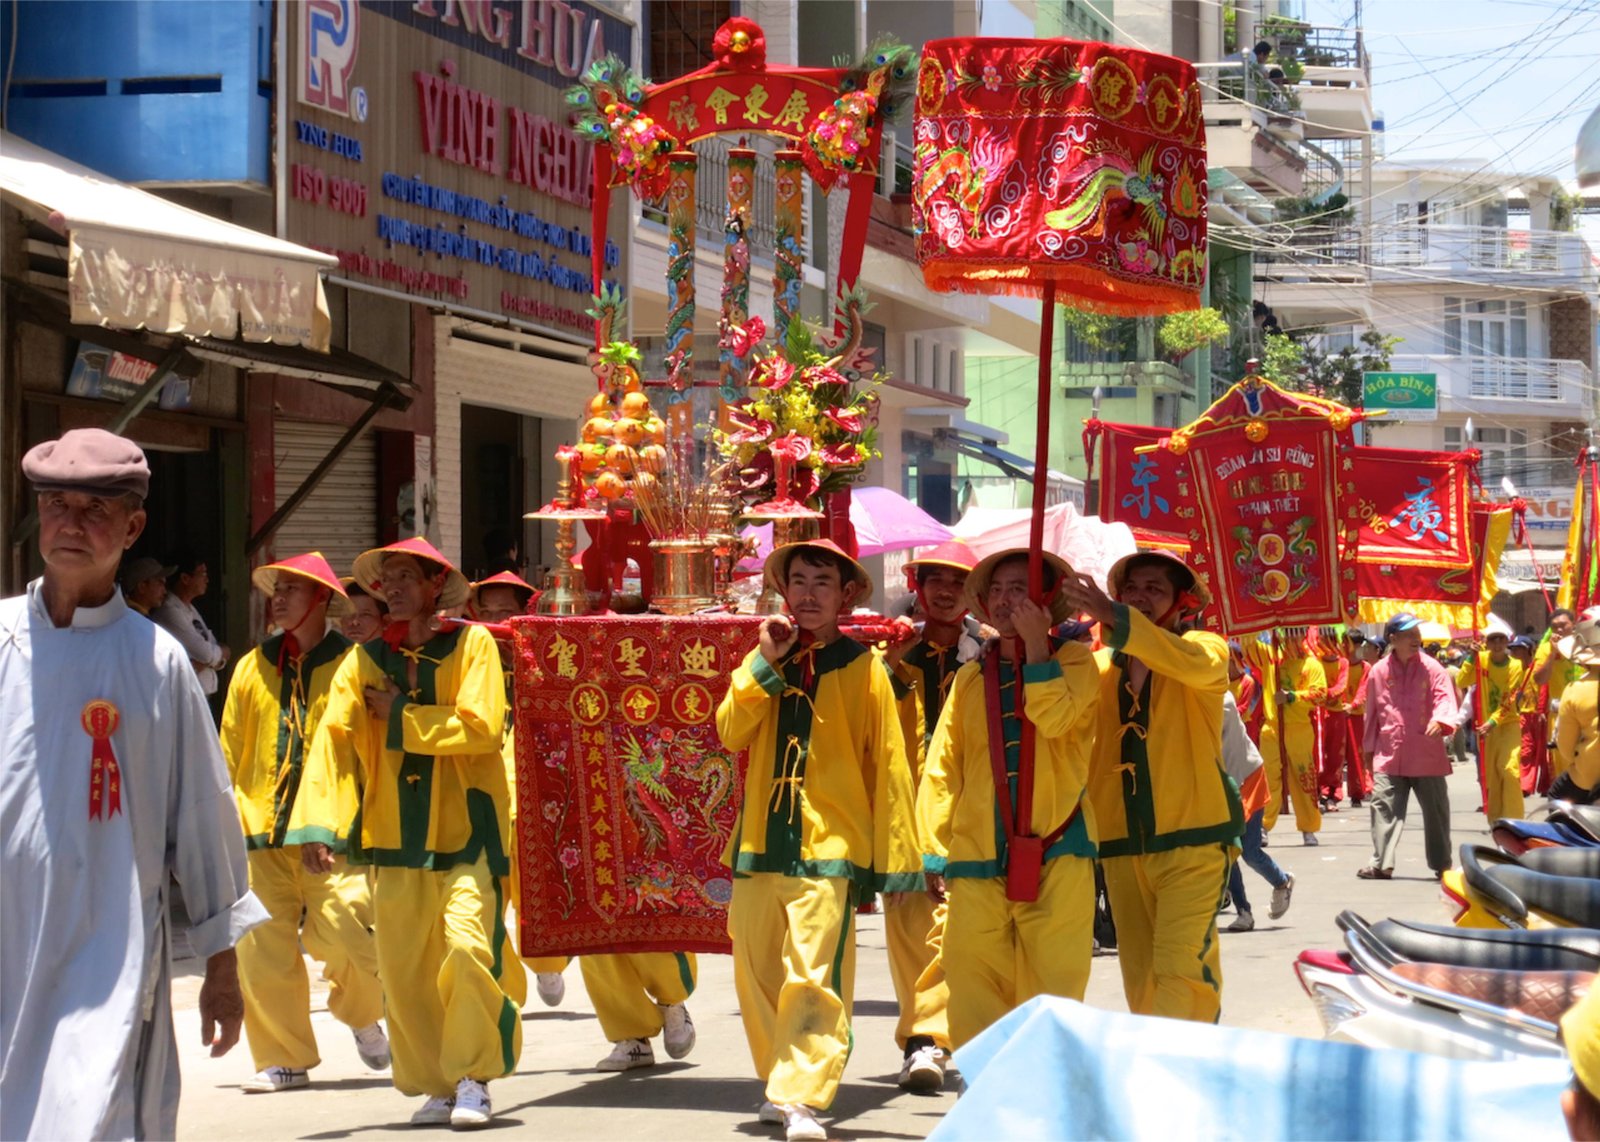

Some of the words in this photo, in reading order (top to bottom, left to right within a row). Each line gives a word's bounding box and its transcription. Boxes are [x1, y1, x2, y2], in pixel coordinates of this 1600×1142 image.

[331, 133, 363, 163] HUA
[291, 163, 325, 206] ISO
[1366, 376, 1396, 395] HÒA
[1399, 376, 1434, 397] BÌNH
